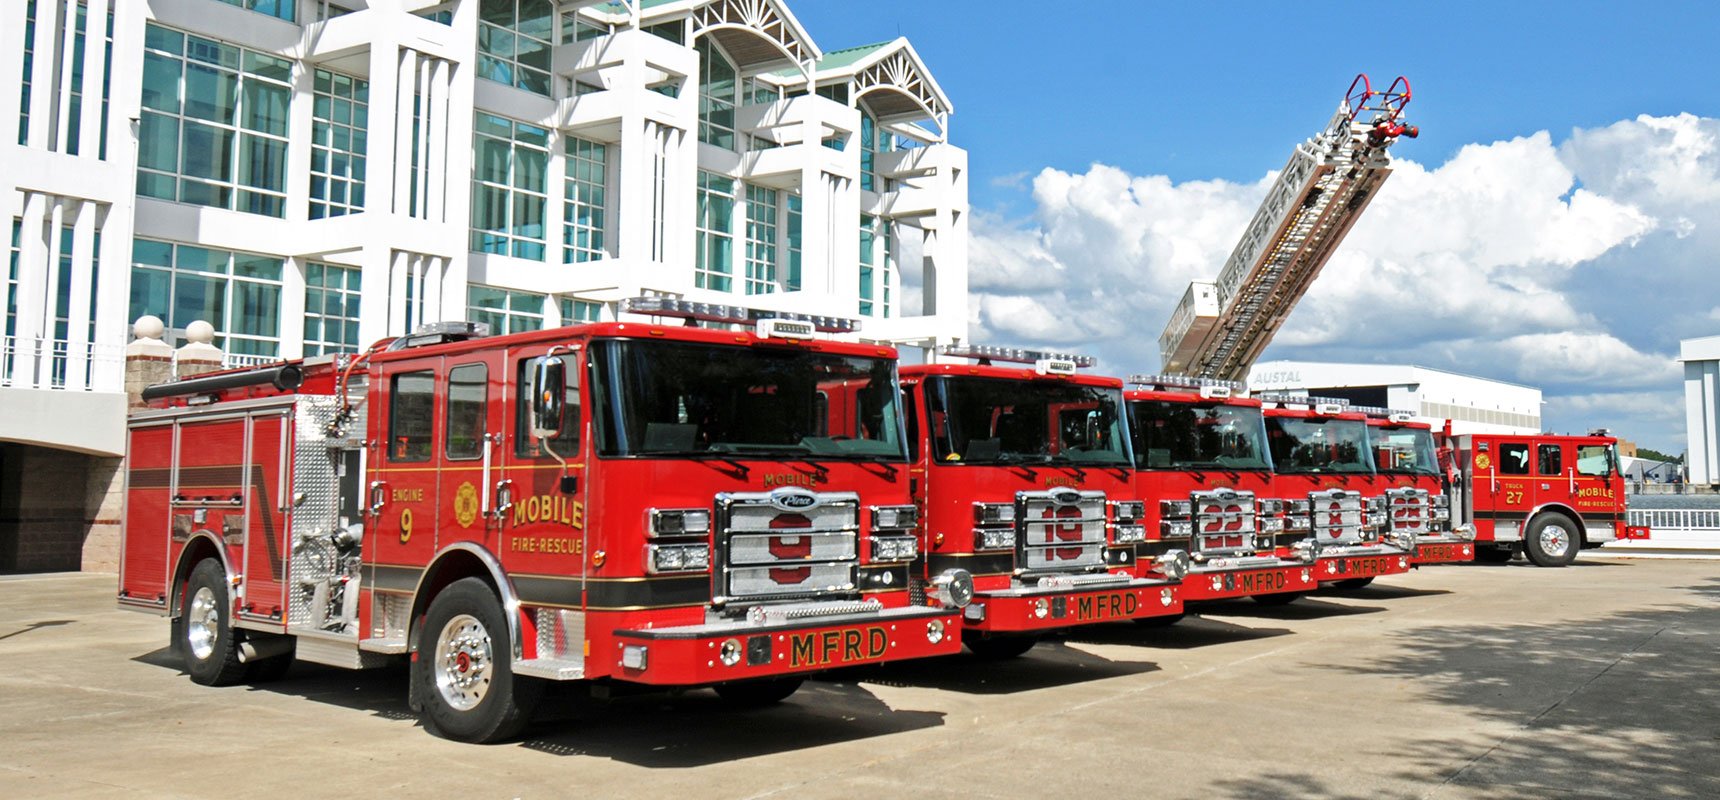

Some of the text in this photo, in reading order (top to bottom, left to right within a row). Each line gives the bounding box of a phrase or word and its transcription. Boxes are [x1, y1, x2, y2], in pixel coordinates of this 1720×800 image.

[1254, 371, 1301, 383] AUSTAL
[764, 474, 817, 486] MOBILE
[1045, 476, 1079, 486] MOBILE
[392, 488, 423, 502] ENGINE
[783, 496, 812, 506] Pierce
[1506, 491, 1523, 504] 27
[1578, 487, 1614, 498] MOBILE
[512, 494, 583, 530] MOBILE
[400, 508, 413, 545] 9
[1042, 505, 1083, 561] 19
[1204, 505, 1243, 548] 22
[511, 537, 583, 554] FIRE-RESCUE
[1424, 546, 1452, 560] MFRD
[1352, 558, 1387, 576] MFRD
[1243, 570, 1286, 593] MFRD
[1078, 592, 1137, 621] MFRD
[789, 626, 887, 668] MFRD
